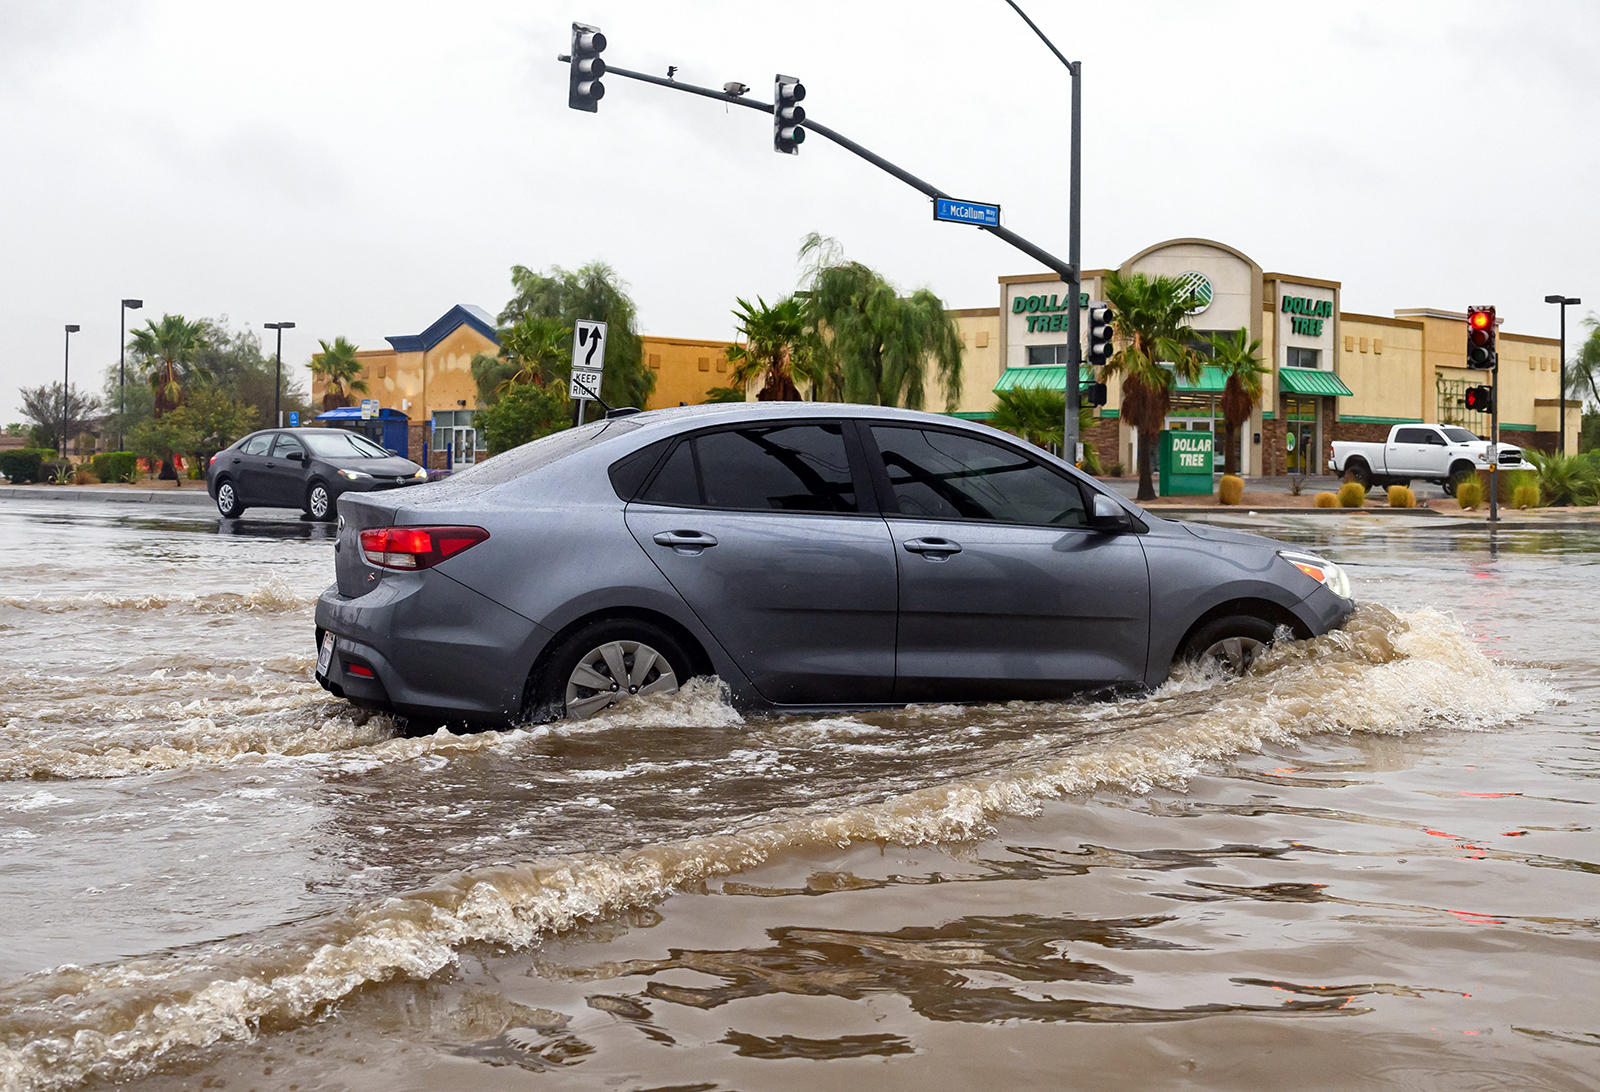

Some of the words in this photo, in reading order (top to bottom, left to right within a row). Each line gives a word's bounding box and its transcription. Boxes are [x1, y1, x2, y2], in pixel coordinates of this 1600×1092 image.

[950, 205, 985, 220] McCallum
[1282, 296, 1332, 318] DOLLAR
[1291, 316, 1324, 337] TREE
[576, 373, 597, 383] KEEP
[1173, 438, 1211, 452] DOLLAR
[1179, 453, 1204, 467] TREE
